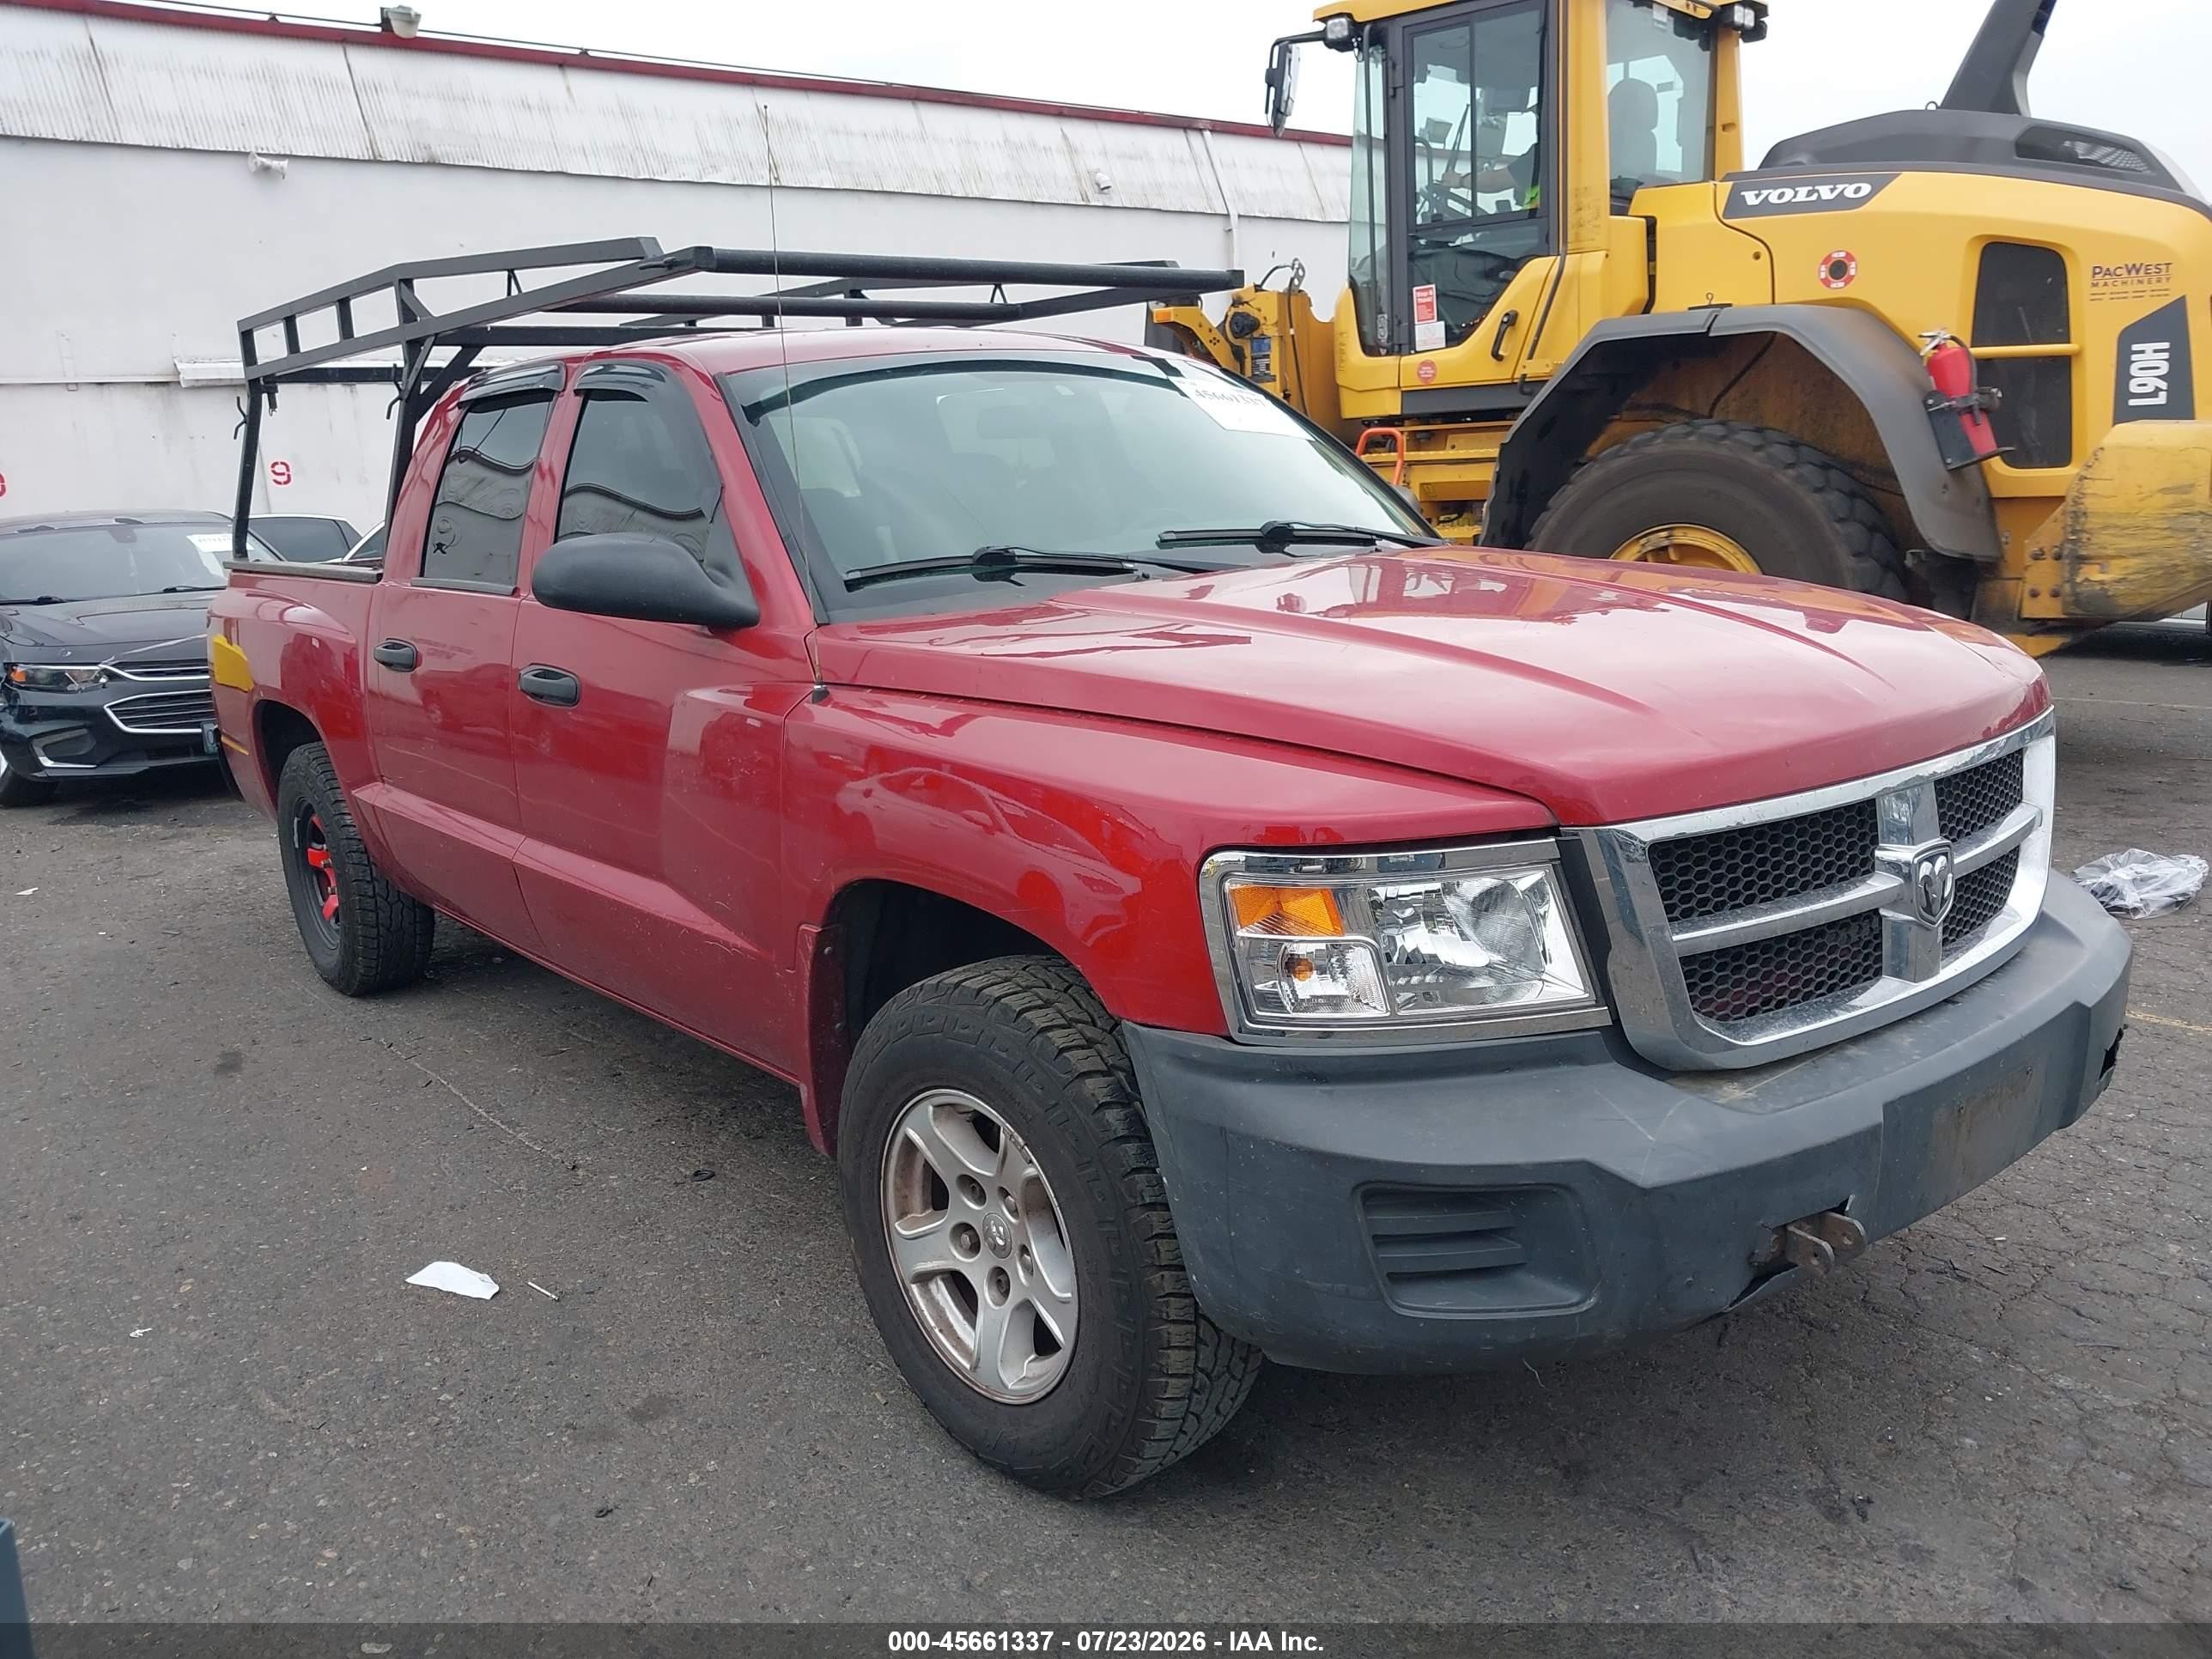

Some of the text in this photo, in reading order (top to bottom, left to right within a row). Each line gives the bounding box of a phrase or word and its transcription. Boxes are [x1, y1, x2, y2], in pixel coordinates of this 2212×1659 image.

[1741, 183, 1872, 206] VOLVO
[2091, 276, 2171, 288] MACHINERY
[2128, 342, 2171, 406] L90H
[270, 461, 291, 485] 9
